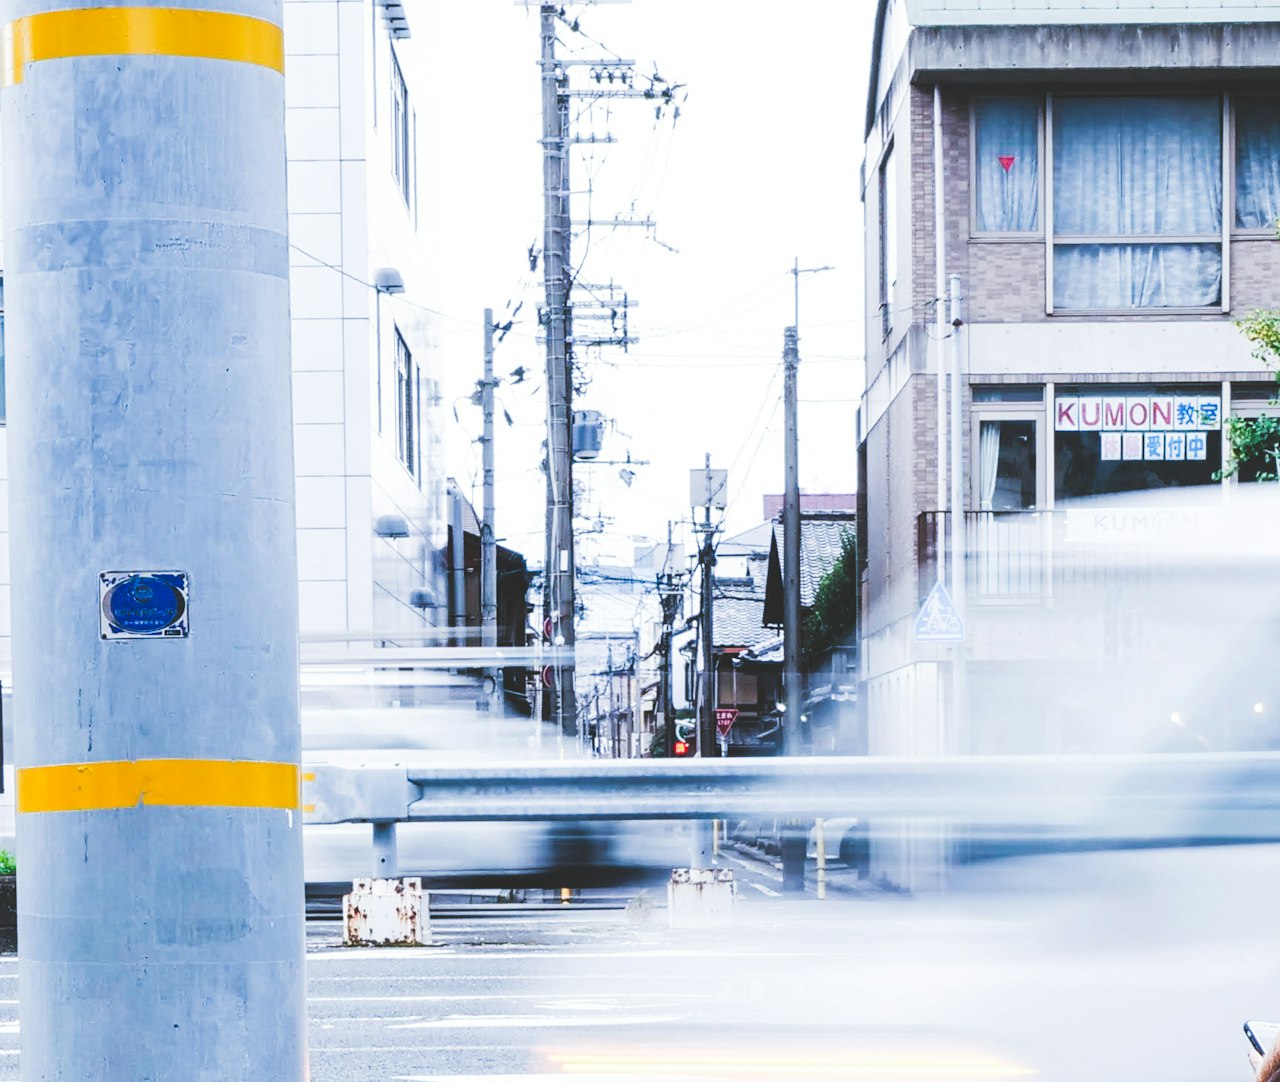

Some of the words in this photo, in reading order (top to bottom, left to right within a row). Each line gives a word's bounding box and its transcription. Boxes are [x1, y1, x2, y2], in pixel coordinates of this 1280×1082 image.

[1103, 433, 1206, 460] 体験受付中
